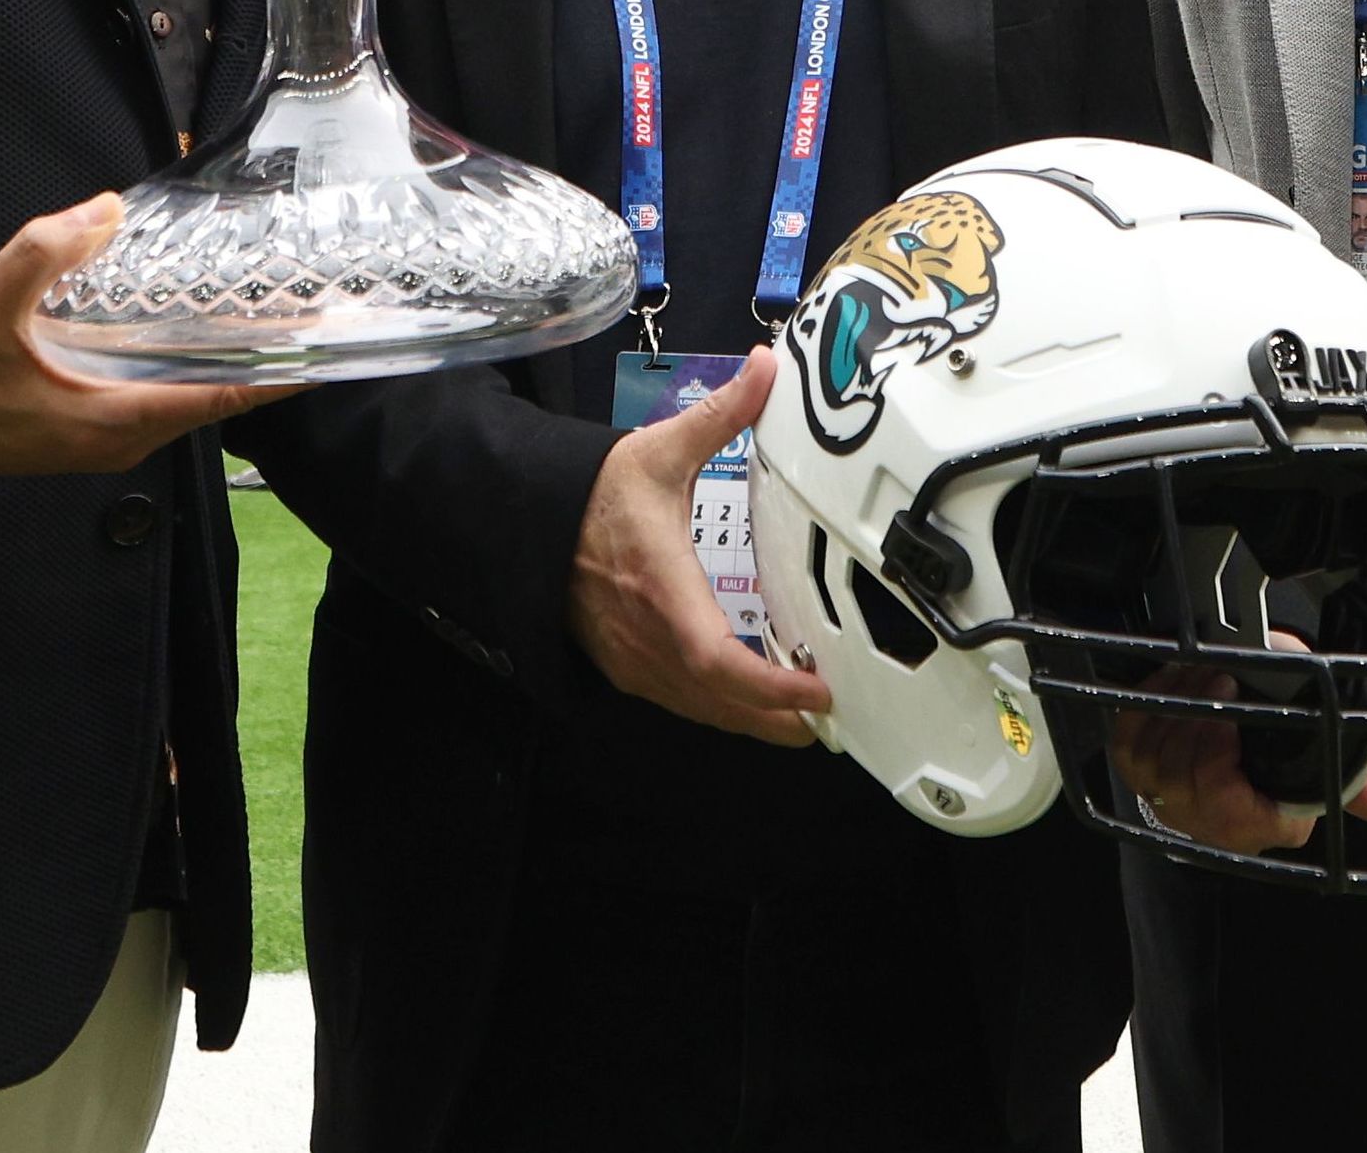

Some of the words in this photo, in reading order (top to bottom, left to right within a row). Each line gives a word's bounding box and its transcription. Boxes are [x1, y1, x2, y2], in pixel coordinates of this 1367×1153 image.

[807, 4, 830, 76] LONDON
[636, 67, 651, 99] NFL
[801, 82, 821, 115] NFL
[637, 104, 651, 144] 2024
[794, 116, 815, 156] 2024
[715, 463, 749, 473] STADIUM
[694, 504, 704, 520] 1
[719, 504, 731, 522] 2
[693, 528, 704, 544] 5
[717, 529, 729, 546] 6
[721, 578, 746, 591] HALF
